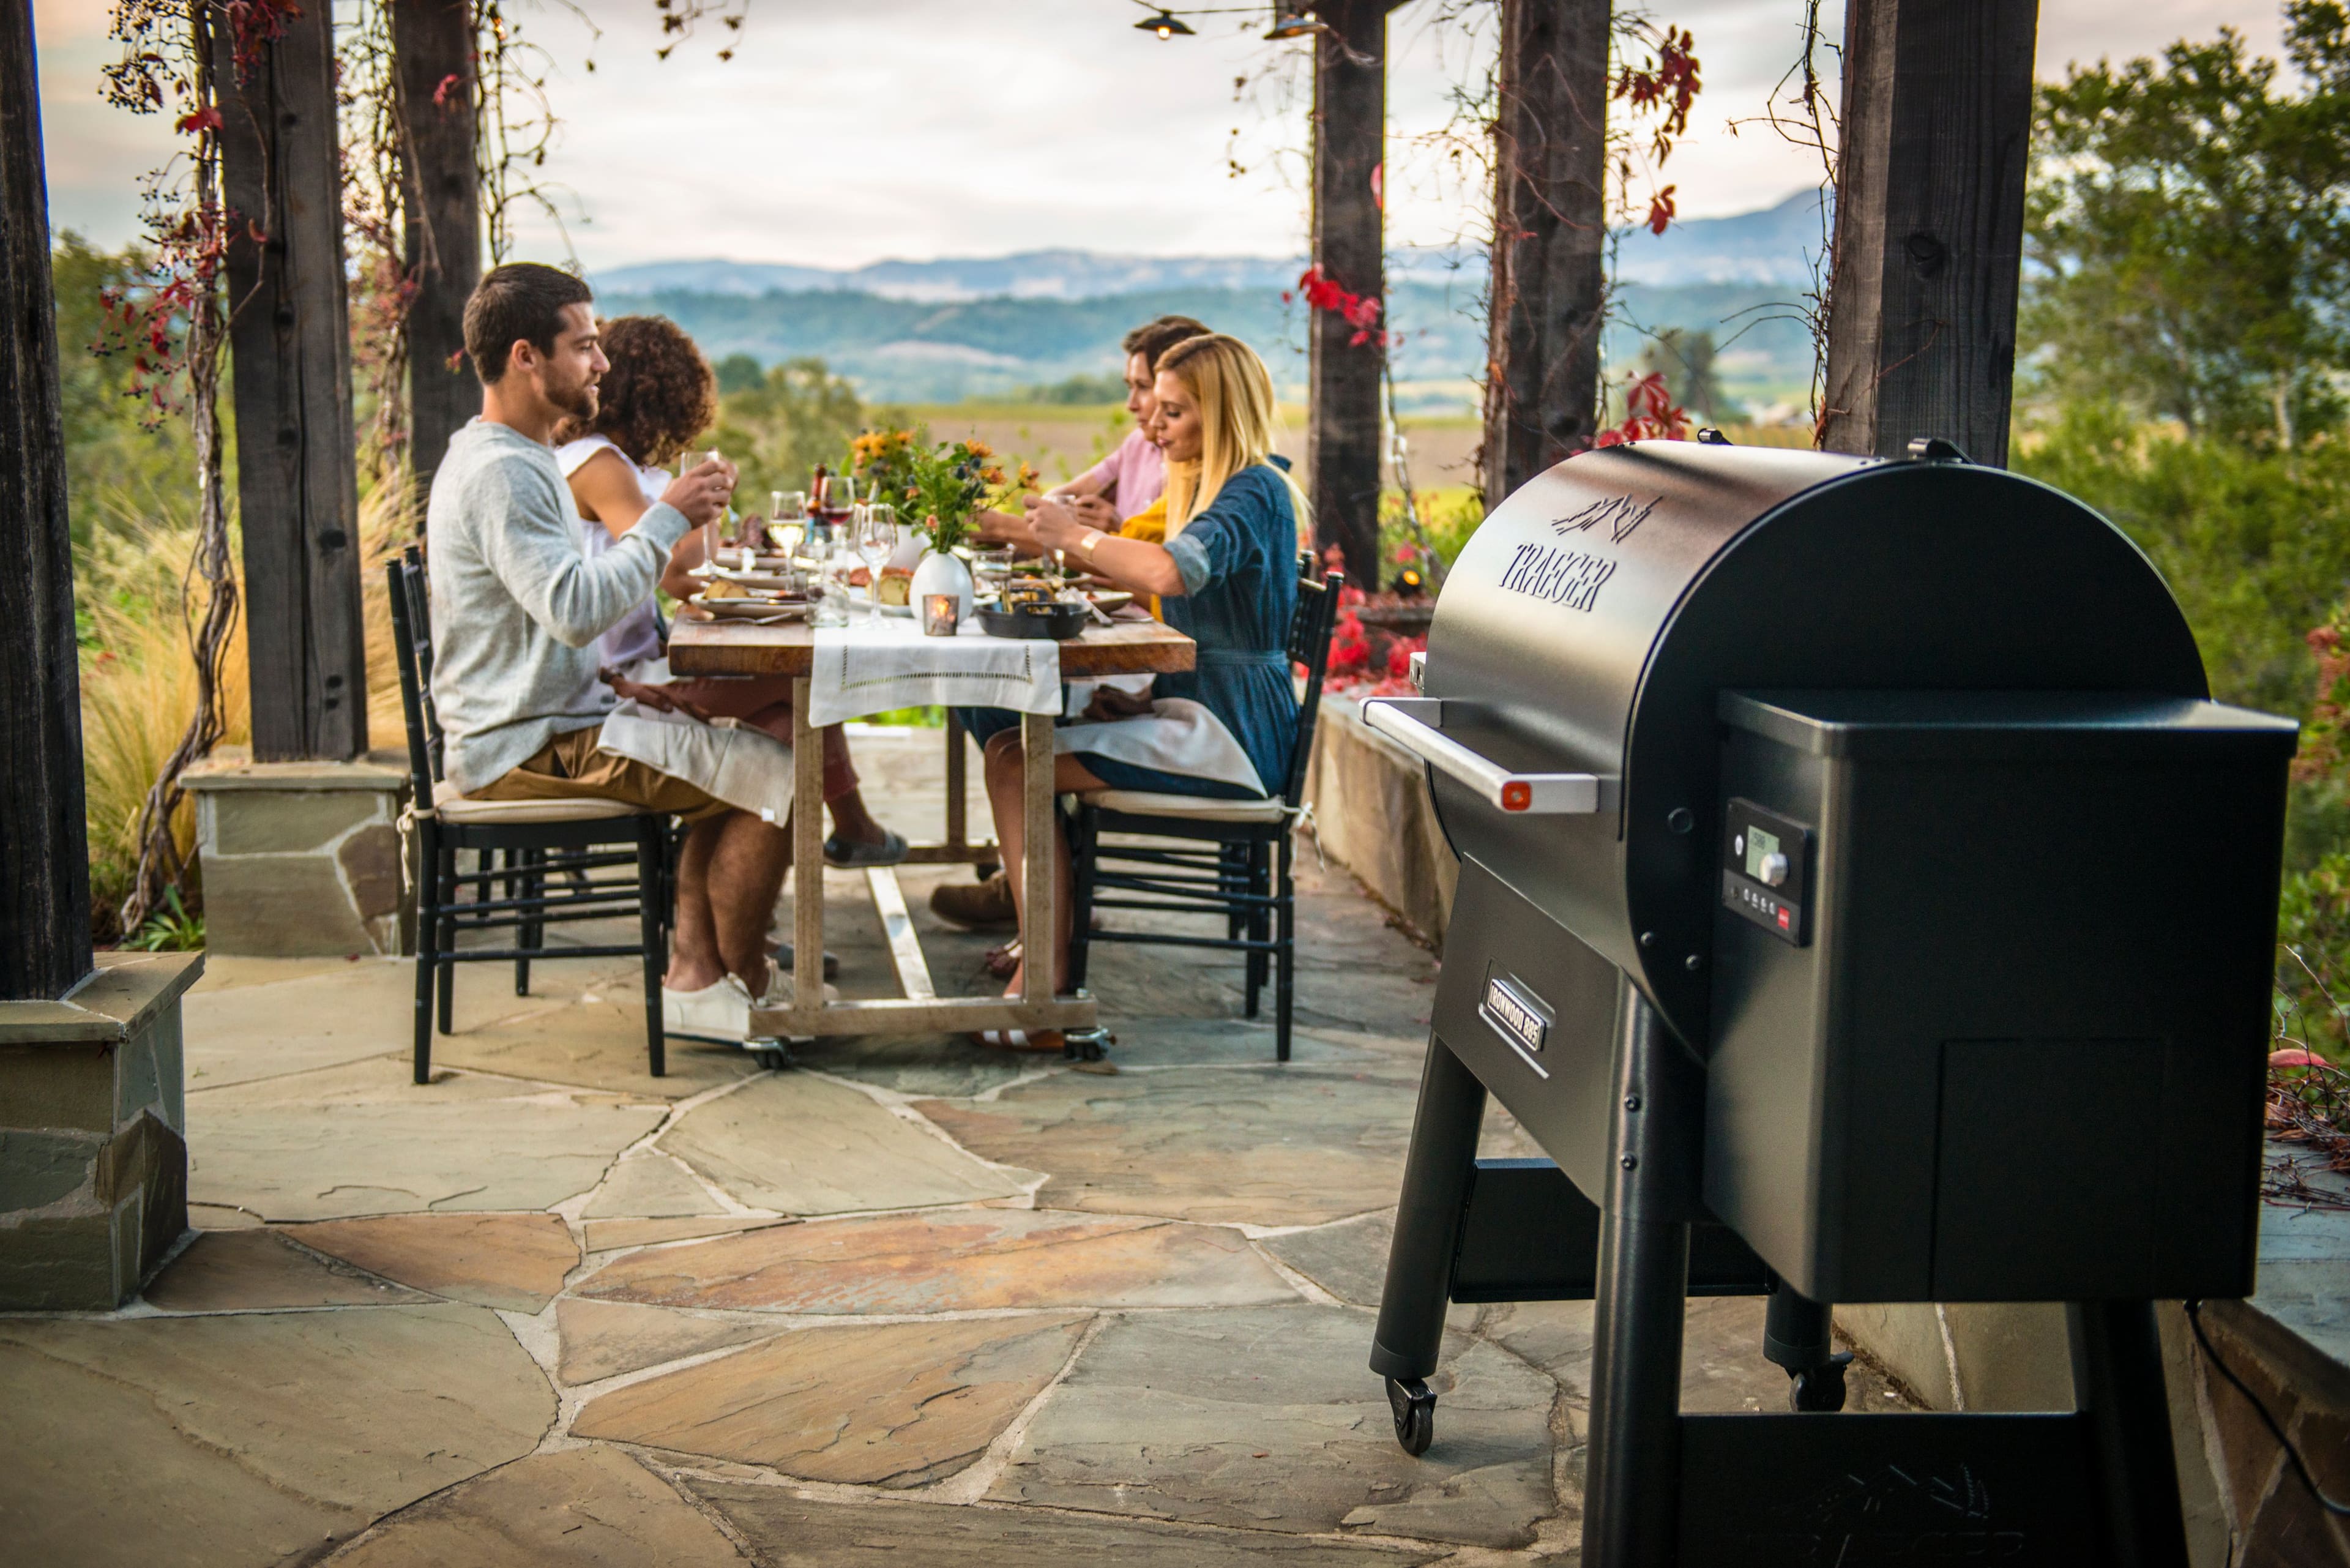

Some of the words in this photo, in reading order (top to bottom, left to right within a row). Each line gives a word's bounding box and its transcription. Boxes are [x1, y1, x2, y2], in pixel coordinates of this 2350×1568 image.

[1499, 542, 1617, 612] TRAEGER
[1490, 985, 1524, 1030] IRONWOOD
[1523, 1017, 1539, 1044] 885
